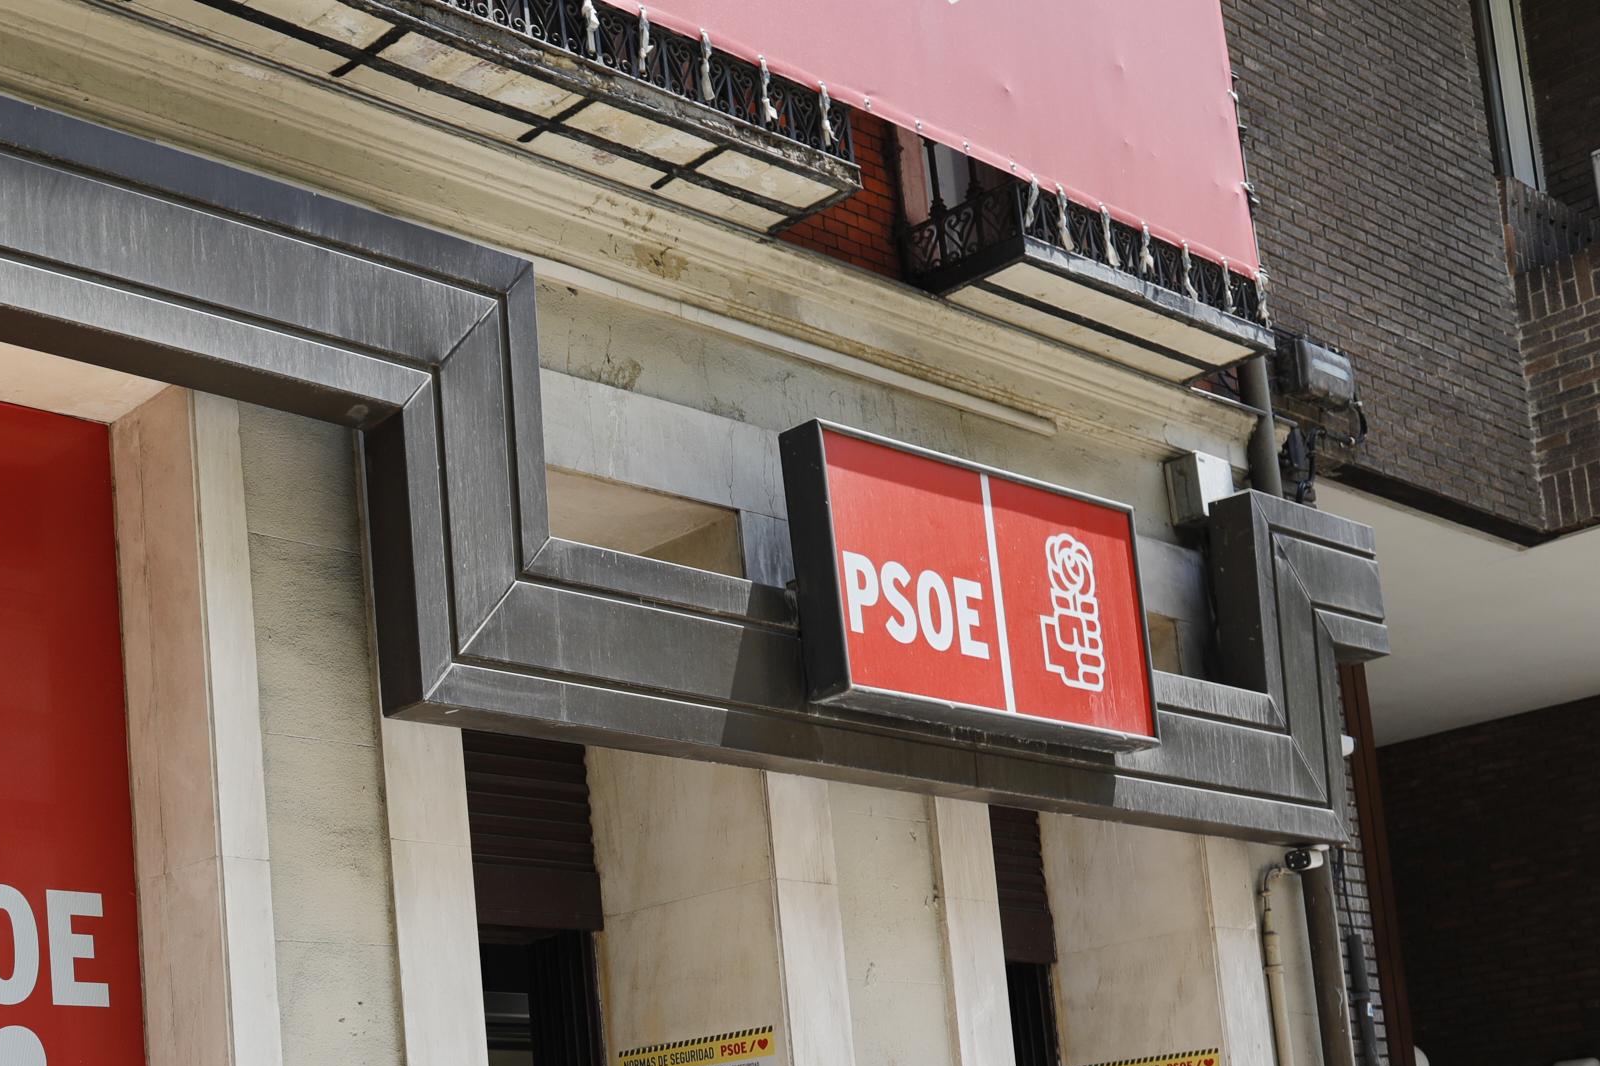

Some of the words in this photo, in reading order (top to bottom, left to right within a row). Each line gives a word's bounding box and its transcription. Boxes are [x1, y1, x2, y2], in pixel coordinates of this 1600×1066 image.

[842, 550, 990, 660] PSOE
[658, 1055, 669, 1066] DE
[670, 1047, 715, 1065] SEGURIDAD
[720, 1041, 747, 1057] PSOE
